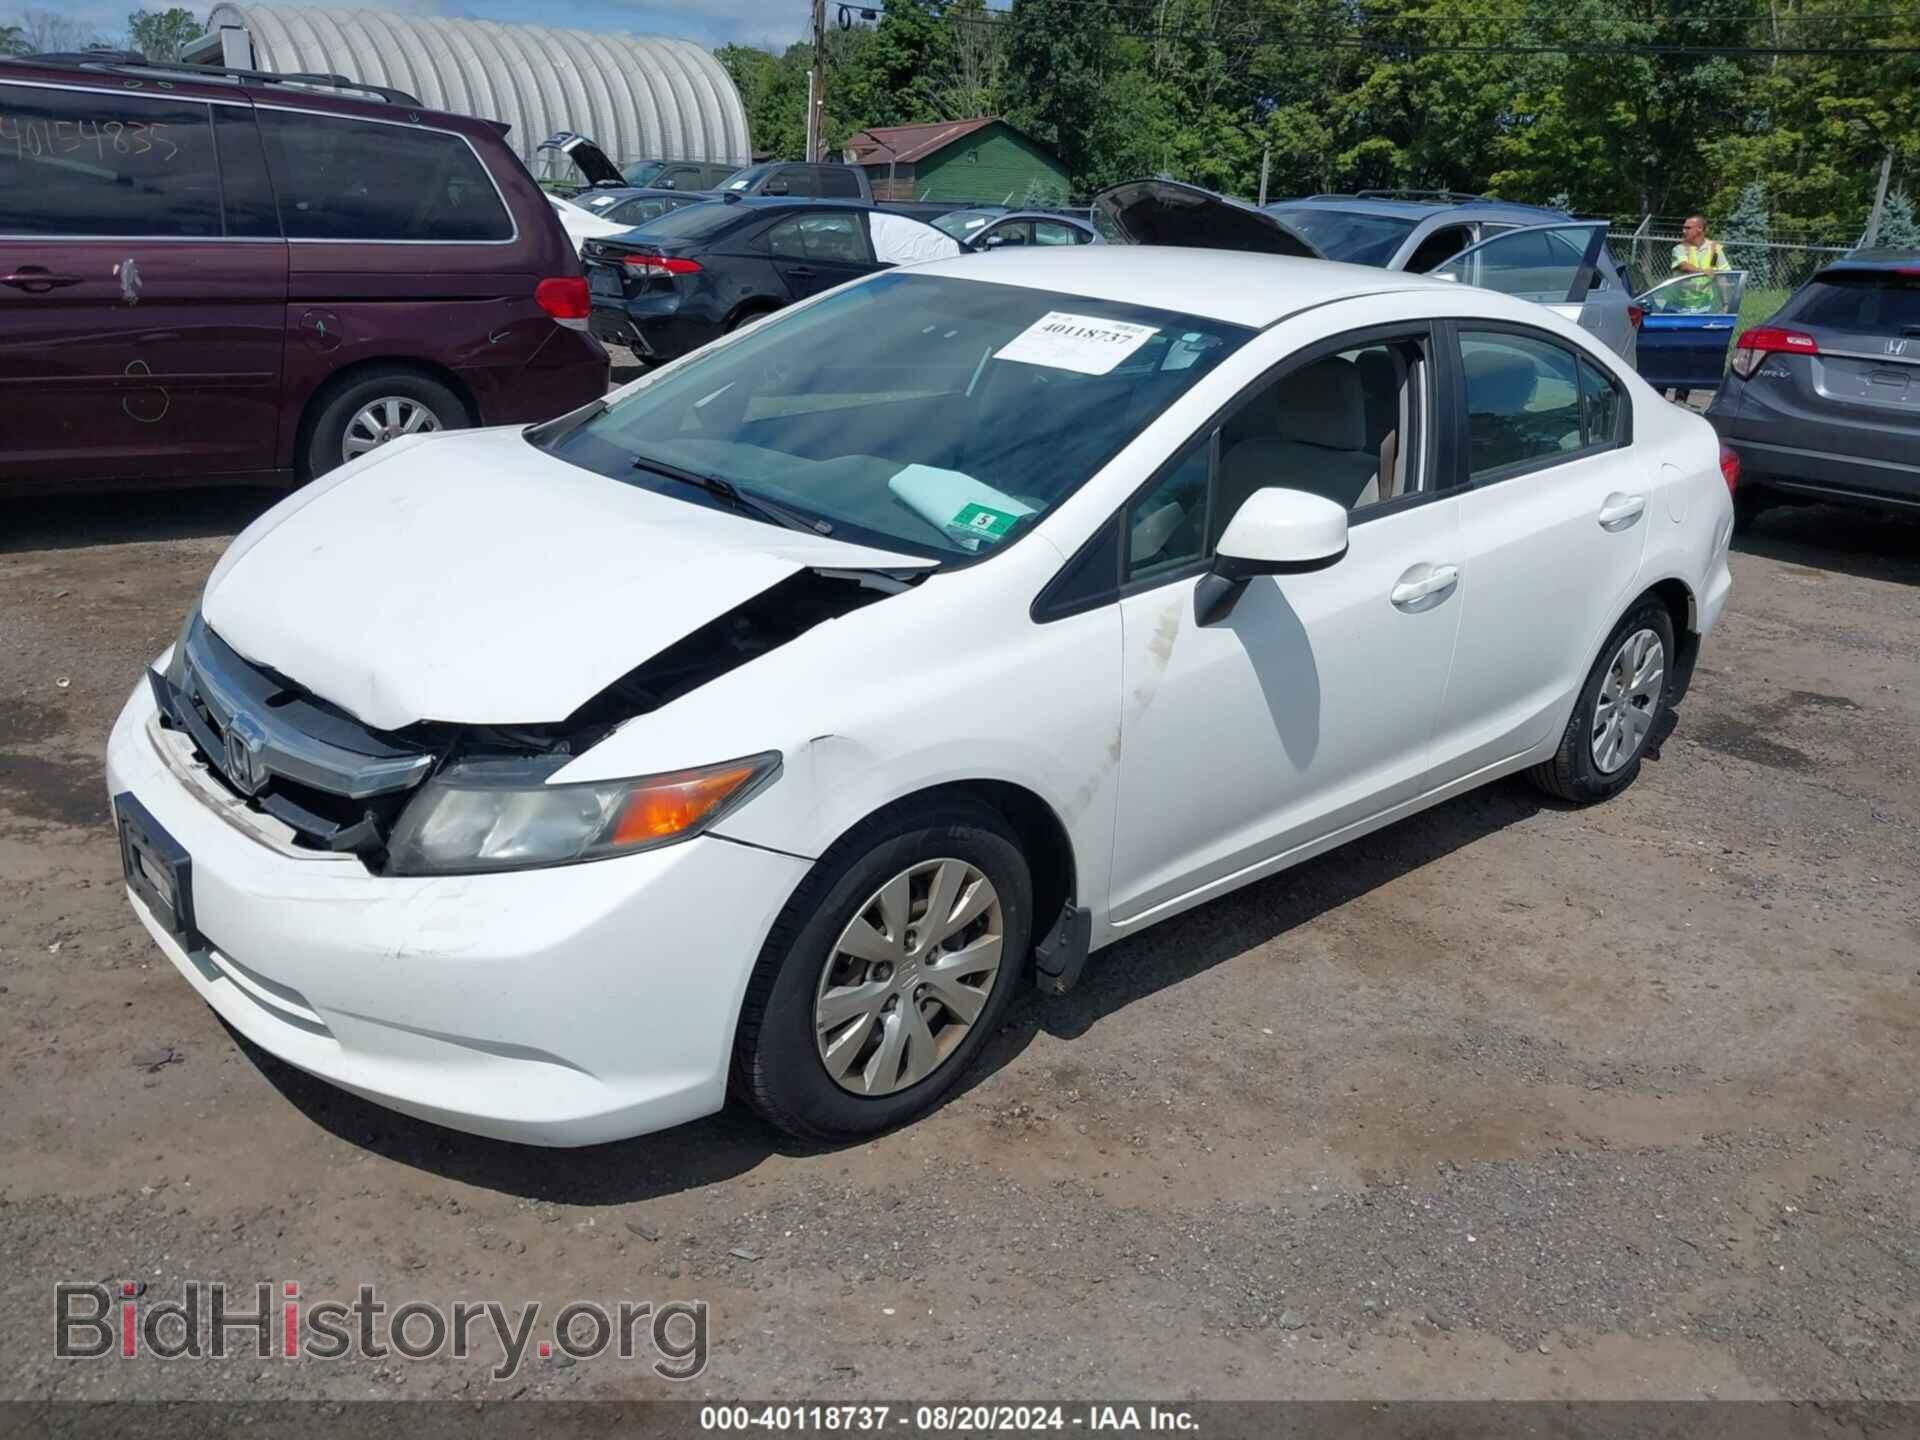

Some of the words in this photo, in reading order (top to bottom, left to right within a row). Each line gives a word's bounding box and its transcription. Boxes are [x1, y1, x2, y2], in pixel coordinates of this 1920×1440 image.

[0, 117, 178, 160] 40154835
[1042, 323, 1133, 344] 40118737
[976, 515, 991, 526] 5
